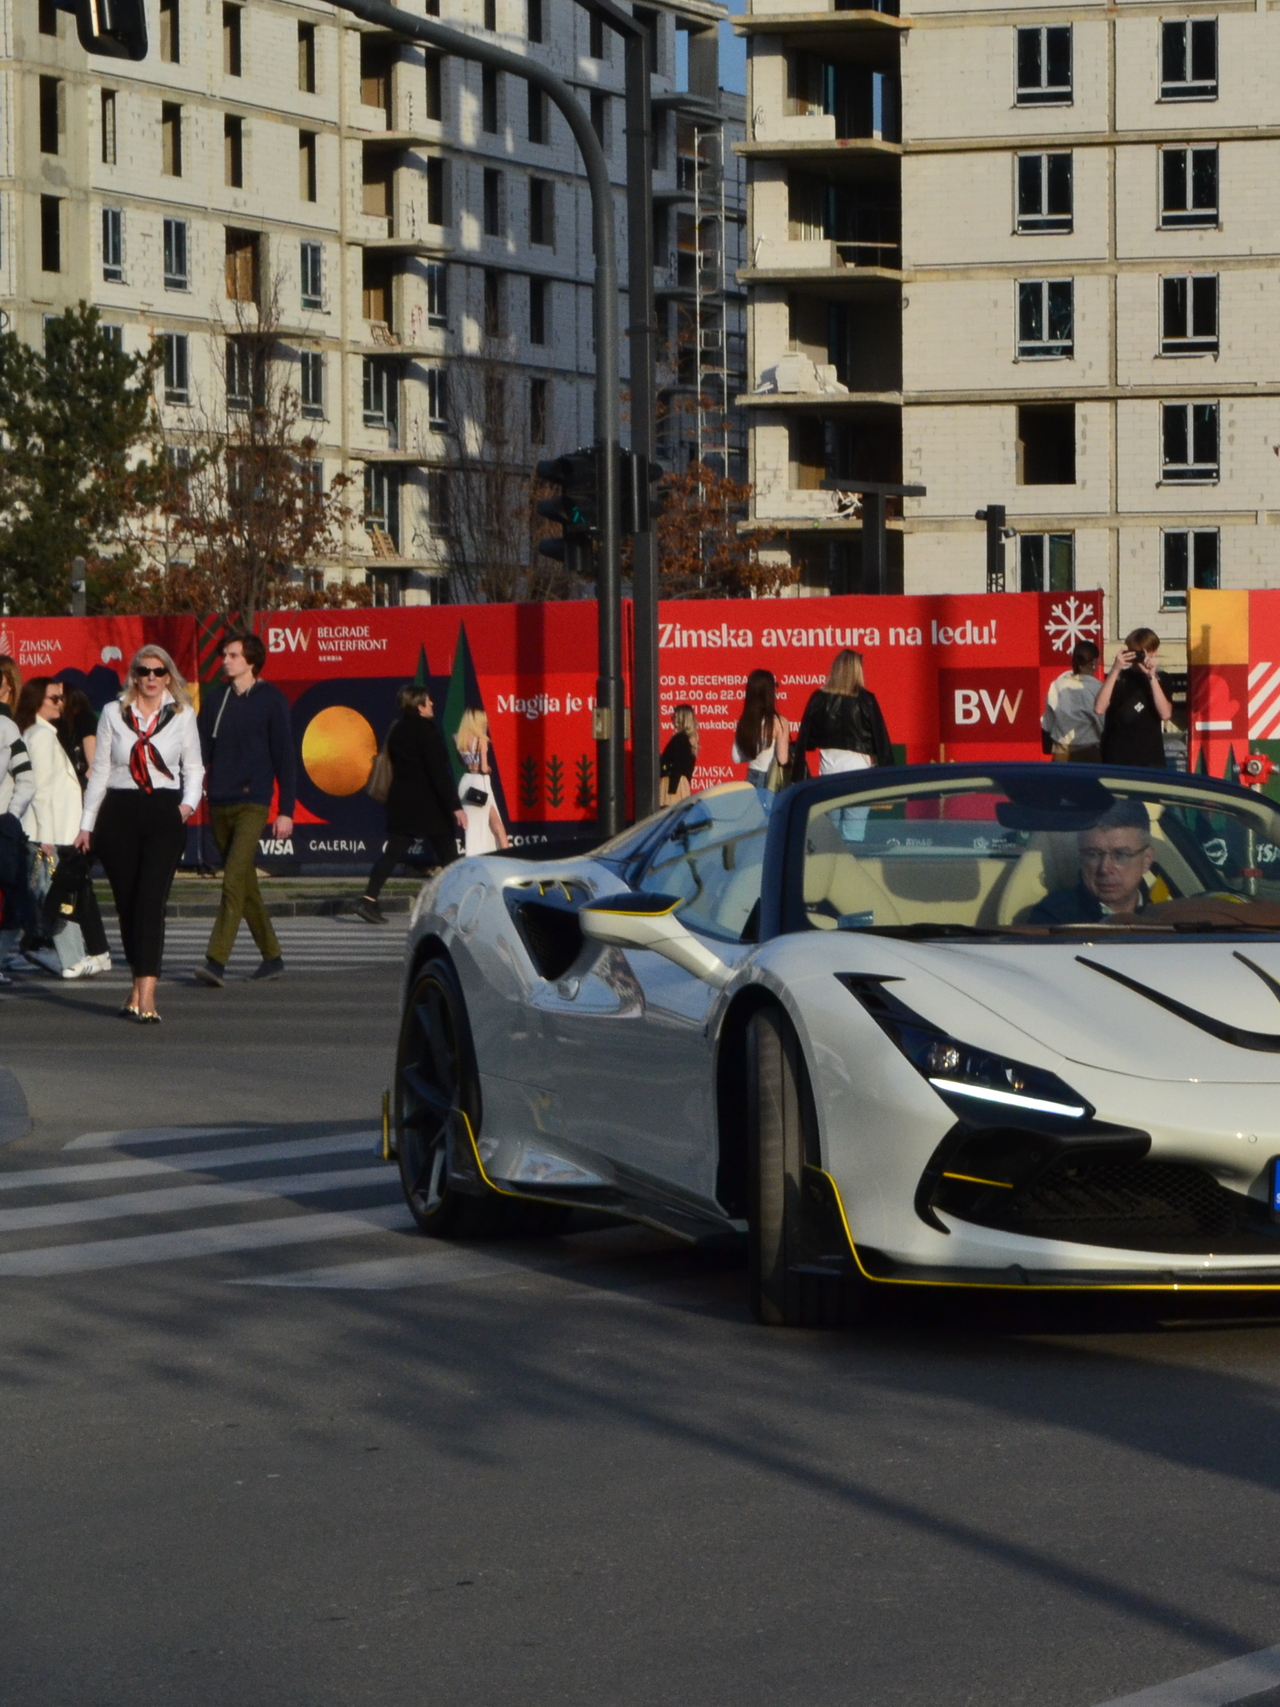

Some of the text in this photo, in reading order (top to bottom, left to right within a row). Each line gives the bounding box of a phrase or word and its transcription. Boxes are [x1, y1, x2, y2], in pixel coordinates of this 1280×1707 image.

[317, 626, 370, 638] BELGRADE
[658, 619, 997, 648] Zimska avantura na ledu!
[19, 639, 63, 652] ZIMSKA
[268, 628, 312, 653] BW
[317, 639, 388, 652] WATERFRONT
[19, 653, 53, 667] BAJKA
[660, 675, 676, 686] OD
[678, 675, 688, 686] 8.
[690, 674, 749, 686] DECEMBRA
[780, 675, 827, 685] JANUAR
[660, 690, 673, 700] od
[675, 690, 704, 701] 12.00
[705, 690, 719, 700] do
[497, 692, 598, 720] Magija je t
[700, 704, 729, 715] PARK
[954, 689, 1023, 725] BW
[691, 766, 734, 777] ZIMSKA
[259, 839, 295, 856] VISA
[309, 840, 367, 854] GALERIJA
